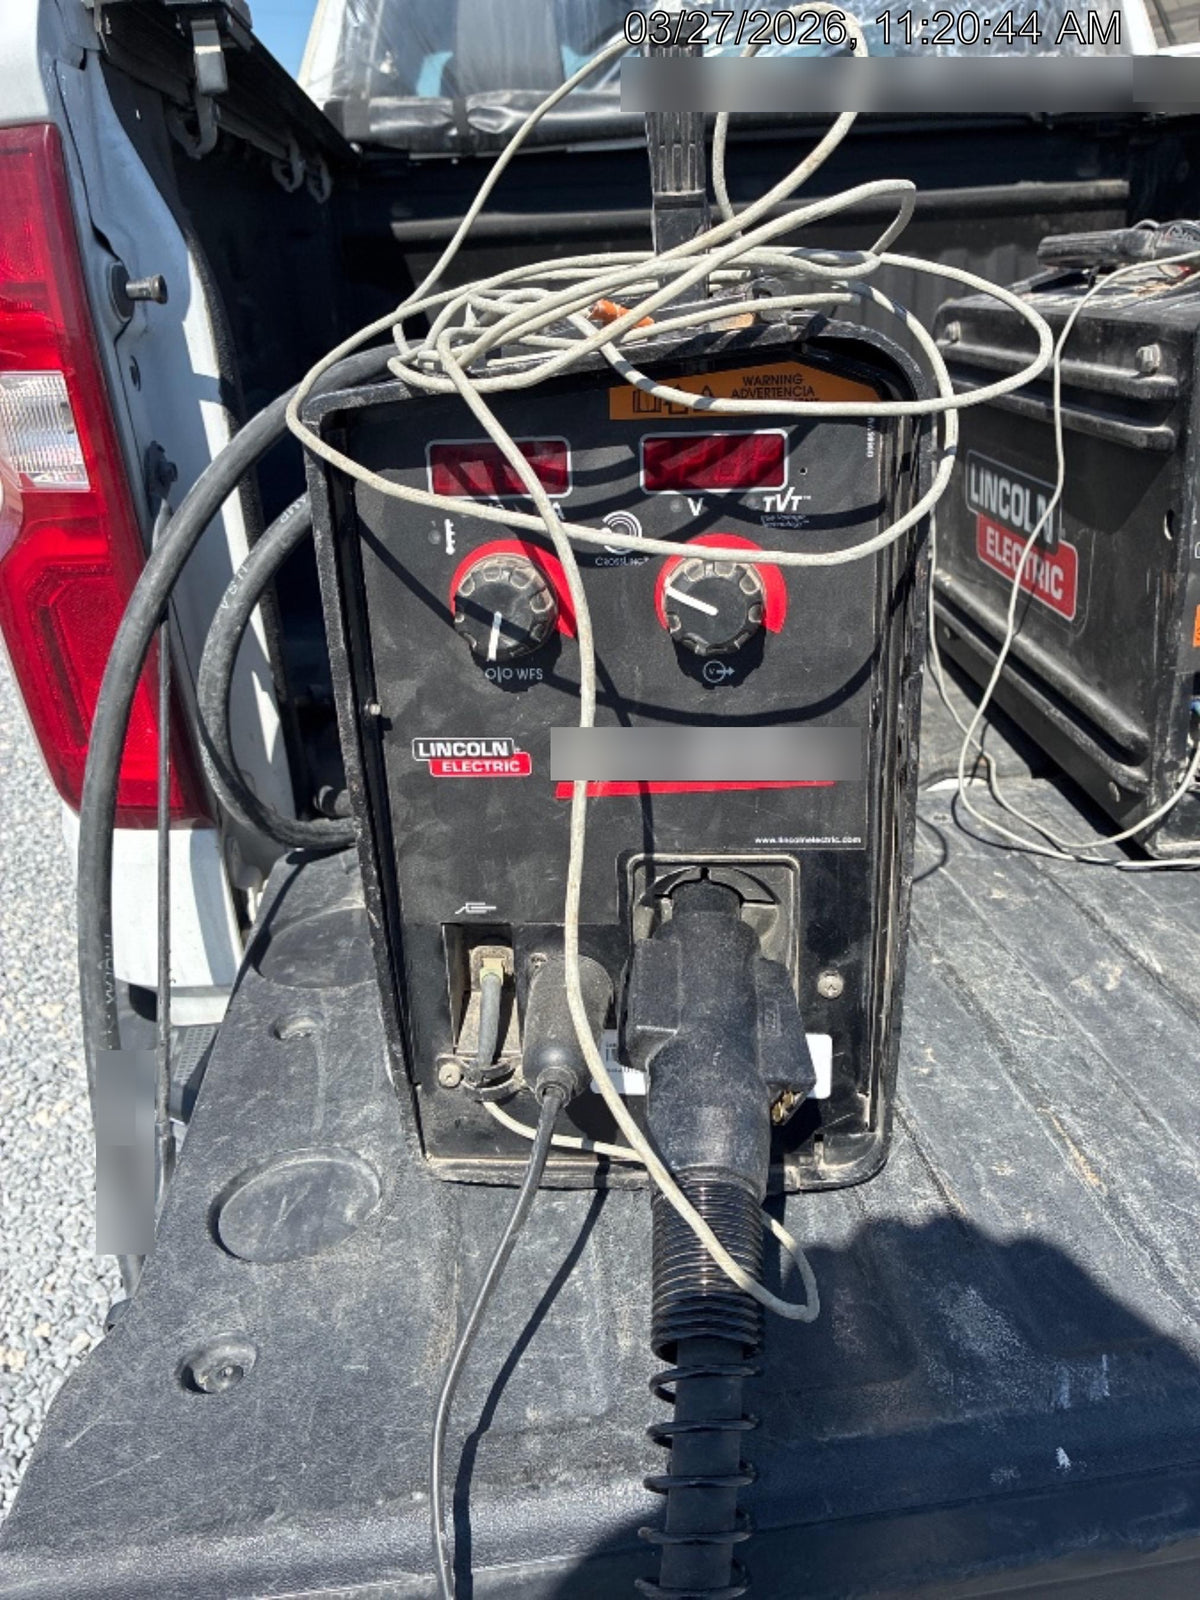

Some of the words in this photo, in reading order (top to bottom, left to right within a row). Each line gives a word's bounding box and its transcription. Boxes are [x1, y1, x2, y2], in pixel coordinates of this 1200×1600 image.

[742, 374, 803, 386] WARNING
[731, 386, 815, 399] ADVERTENCIA
[687, 497, 704, 516] V
[970, 463, 1054, 545] LINCOLN
[985, 525, 1064, 601] ELECTRIC
[515, 667, 543, 680] WFS
[418, 741, 509, 757] LINCOLN
[442, 760, 520, 772] ELECTRIC
